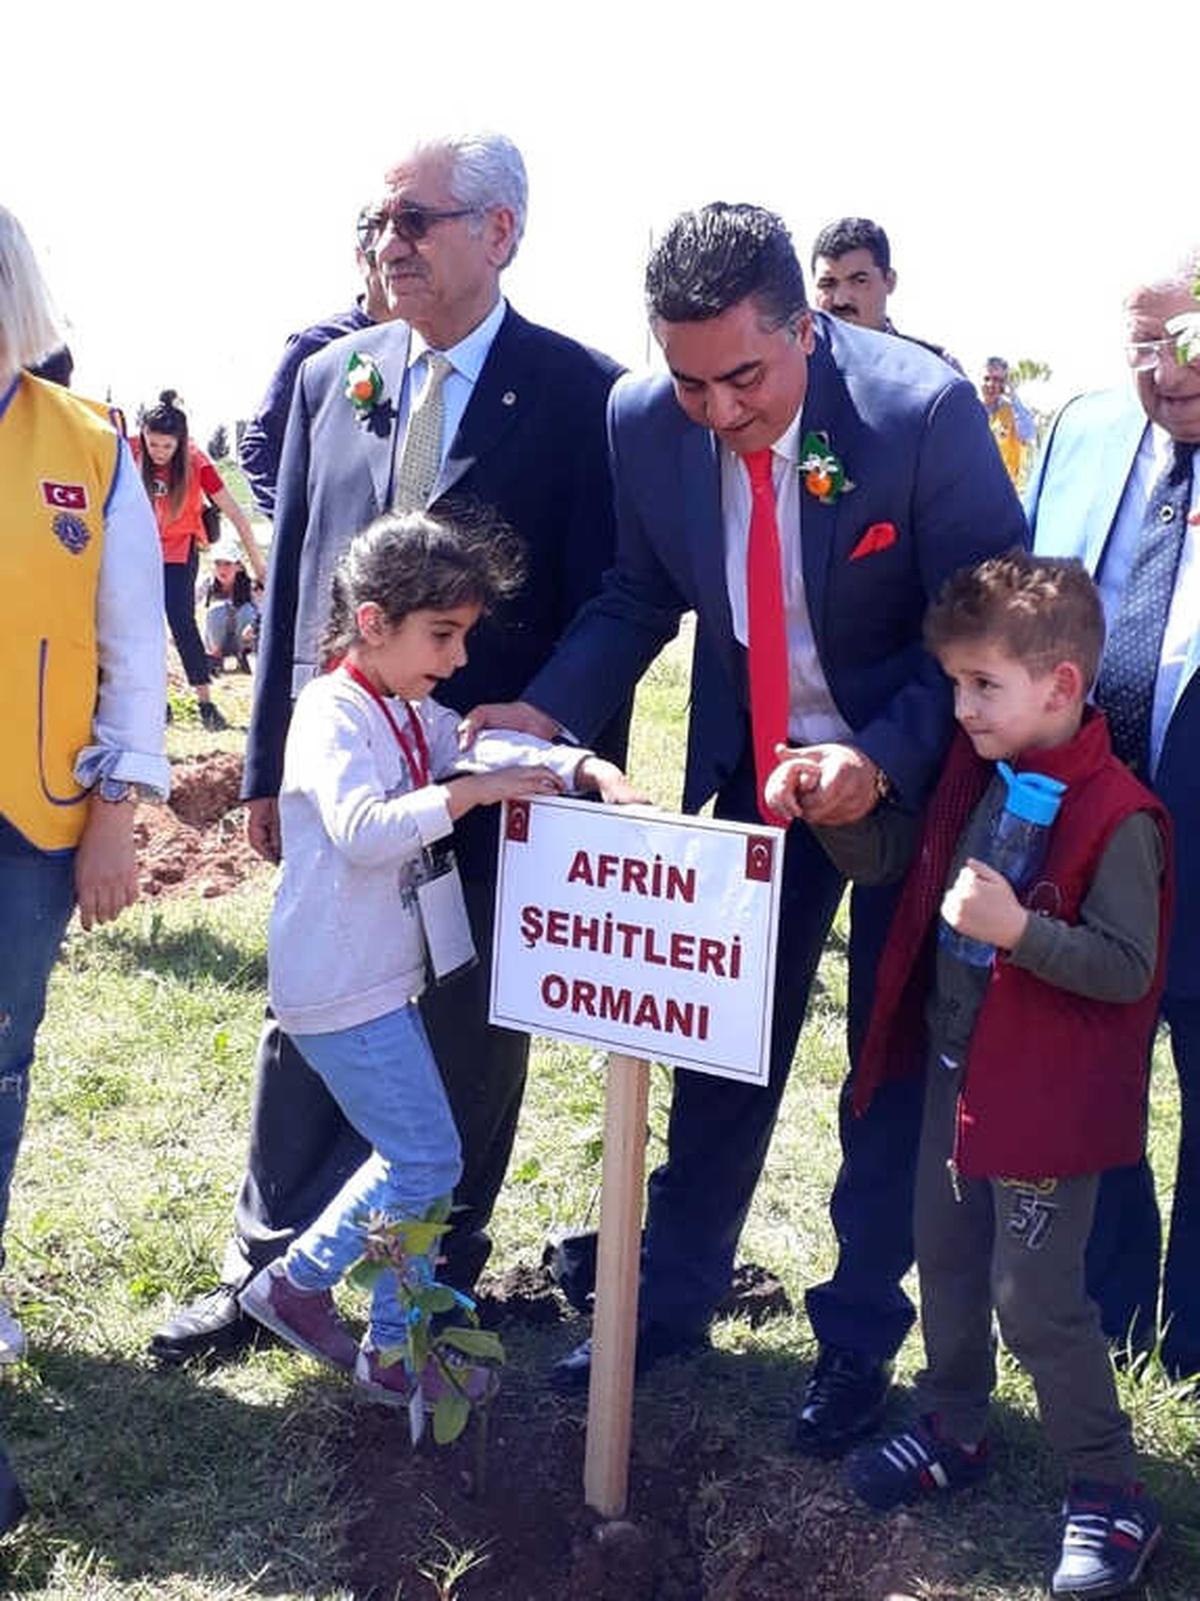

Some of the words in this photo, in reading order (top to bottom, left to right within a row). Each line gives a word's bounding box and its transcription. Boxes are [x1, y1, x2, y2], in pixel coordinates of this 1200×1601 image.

[567, 850, 697, 904] AFRİN
[519, 905, 742, 980] ŞEHİTLERİ
[540, 974, 710, 1041] ORMANI
